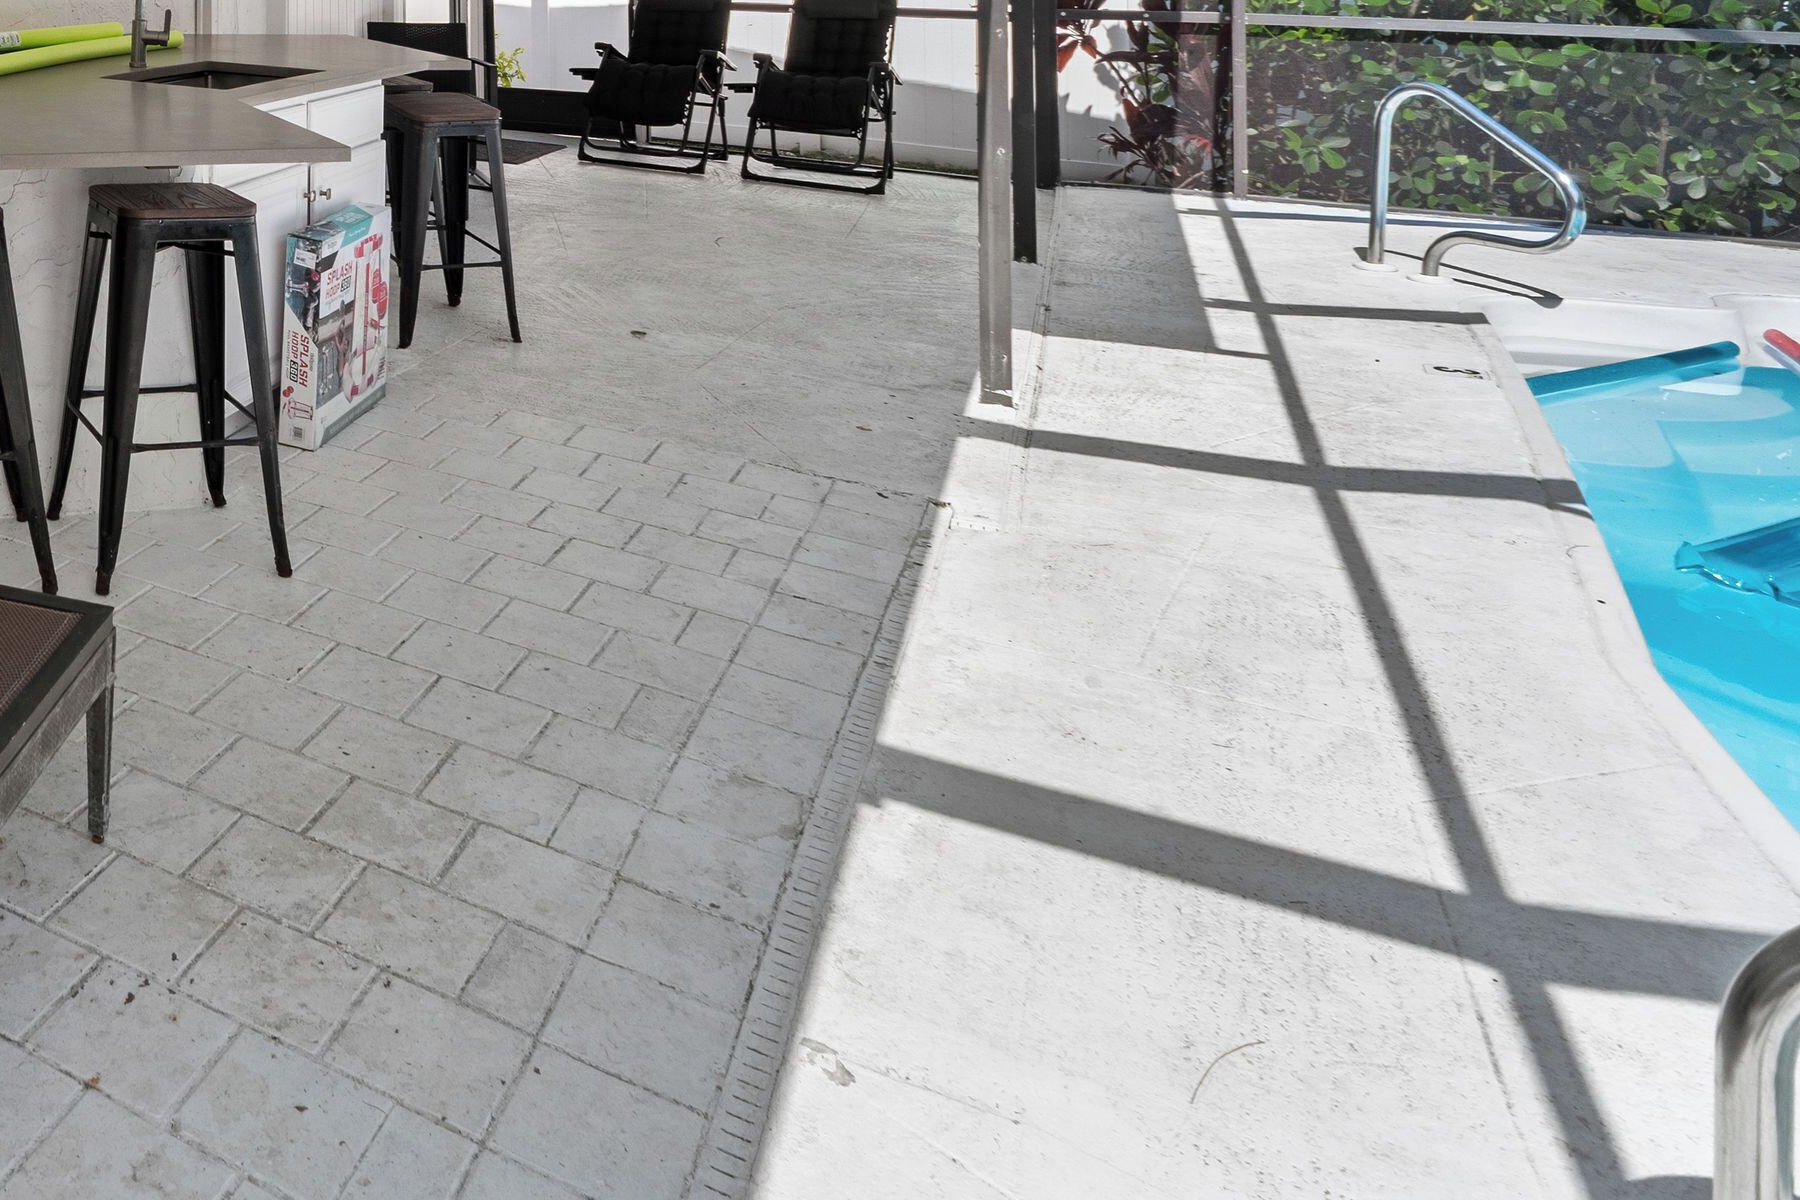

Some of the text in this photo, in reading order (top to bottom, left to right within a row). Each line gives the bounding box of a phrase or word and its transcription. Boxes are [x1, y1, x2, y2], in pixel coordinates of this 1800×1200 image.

[327, 261, 353, 286] SPLASH
[291, 331, 299, 359] HOOP
[299, 334, 309, 388] SPLASH
